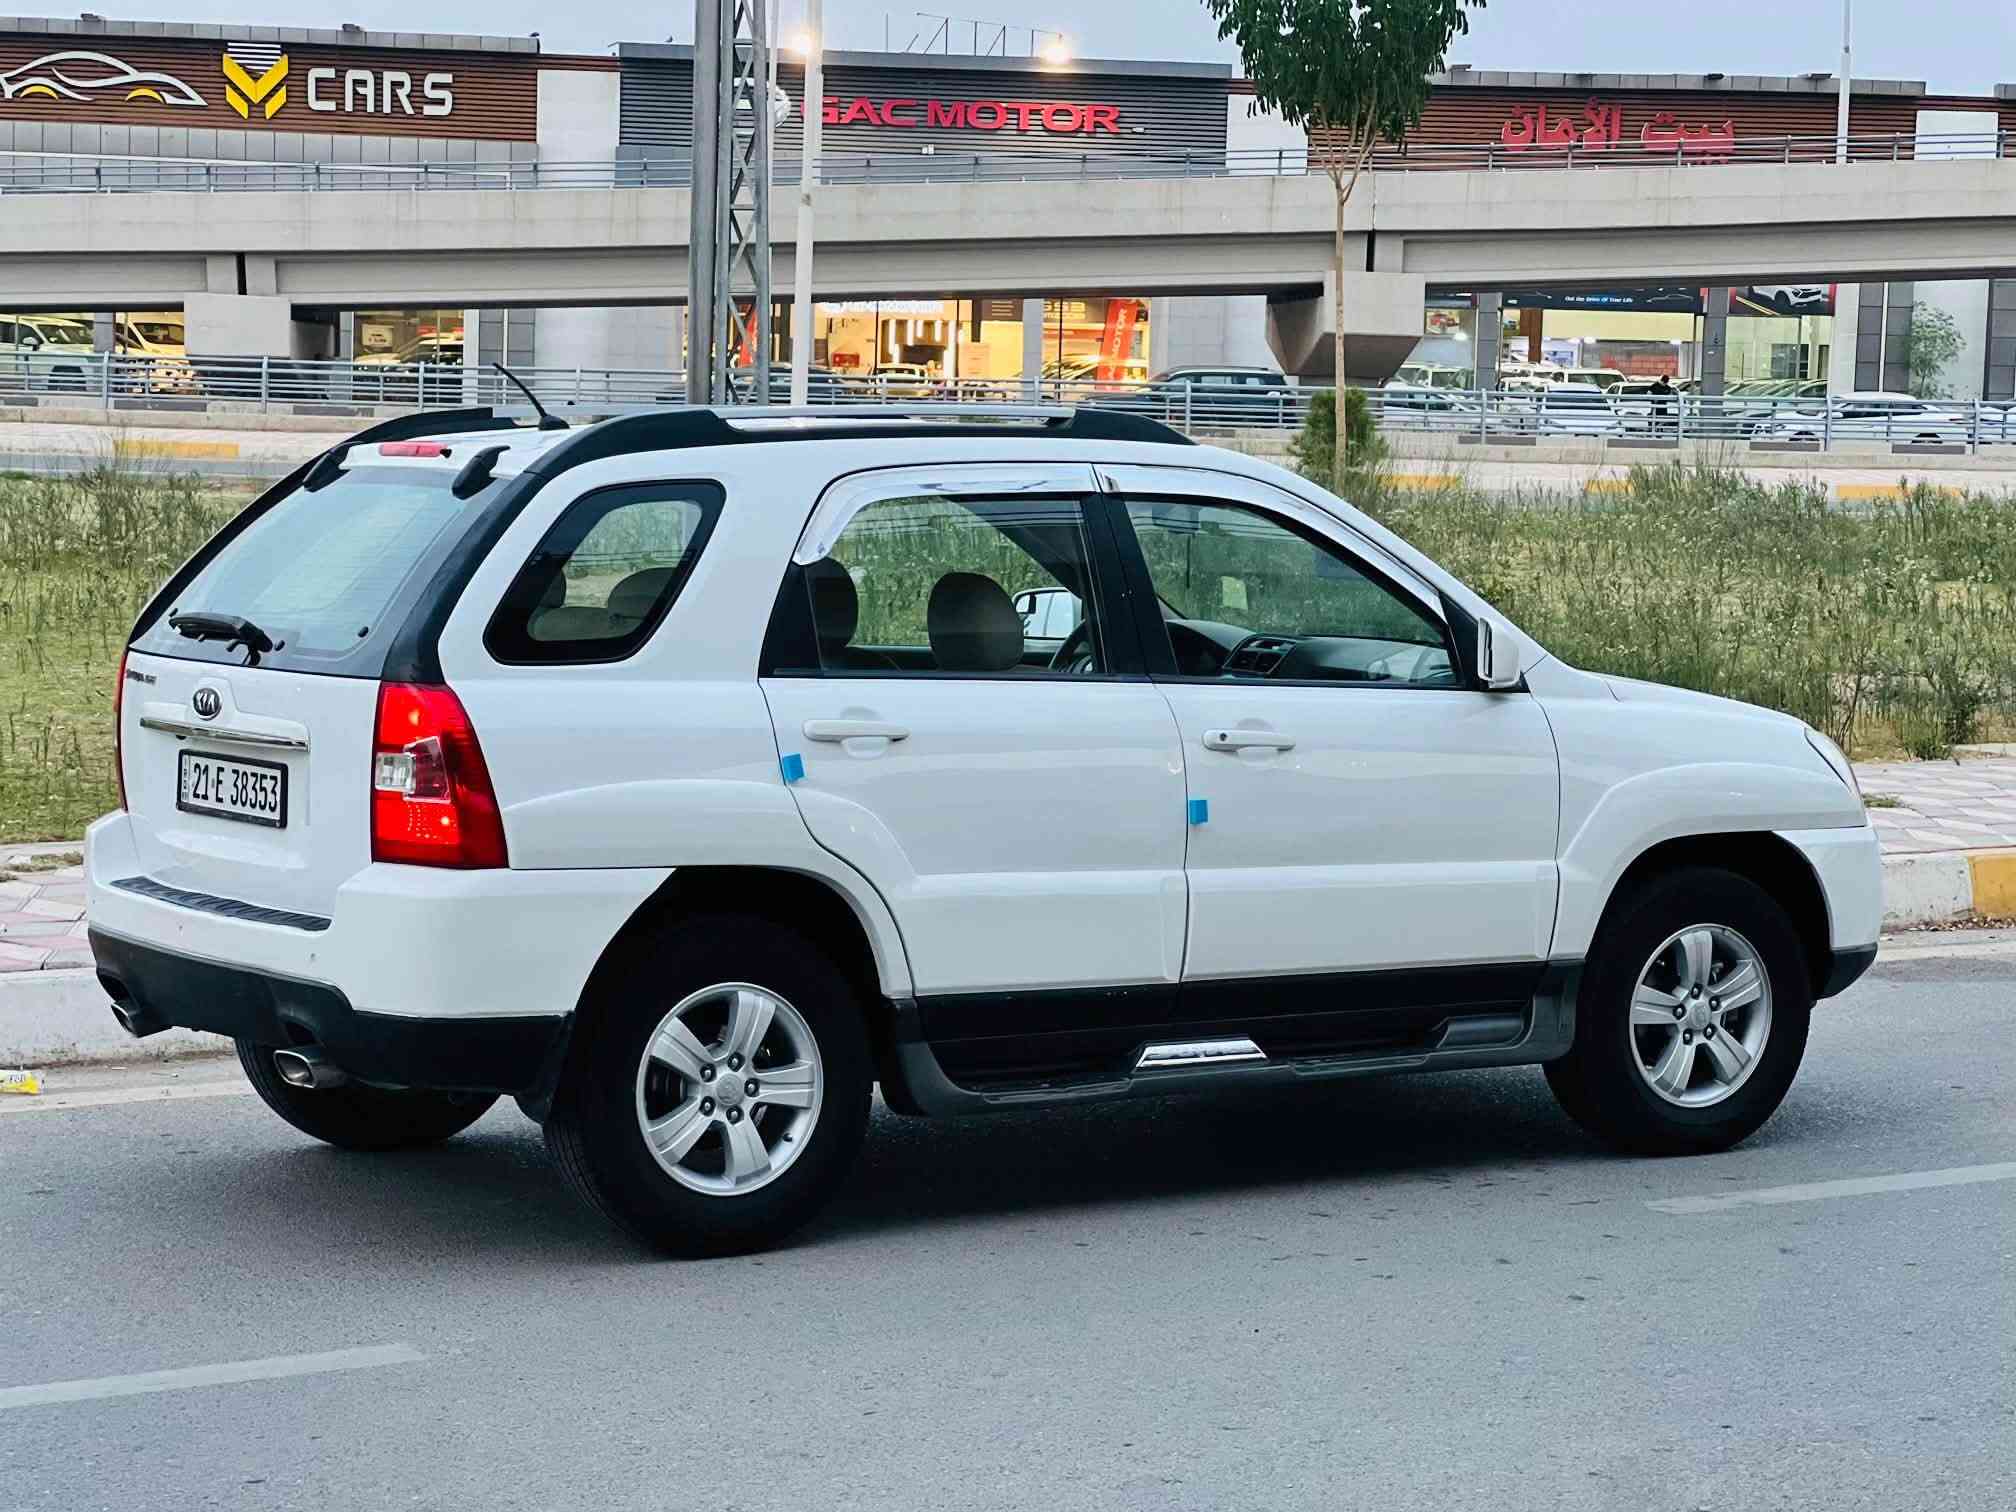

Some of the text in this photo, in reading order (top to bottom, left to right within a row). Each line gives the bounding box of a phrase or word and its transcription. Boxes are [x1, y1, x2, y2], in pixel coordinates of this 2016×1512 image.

[307, 67, 454, 116] CARS
[927, 98, 1121, 135] MOTOR
[1500, 96, 1622, 152] الأمان
[196, 691, 217, 711] KIA
[192, 762, 209, 801] 21
[215, 766, 225, 803] E
[230, 768, 278, 813] 38353
